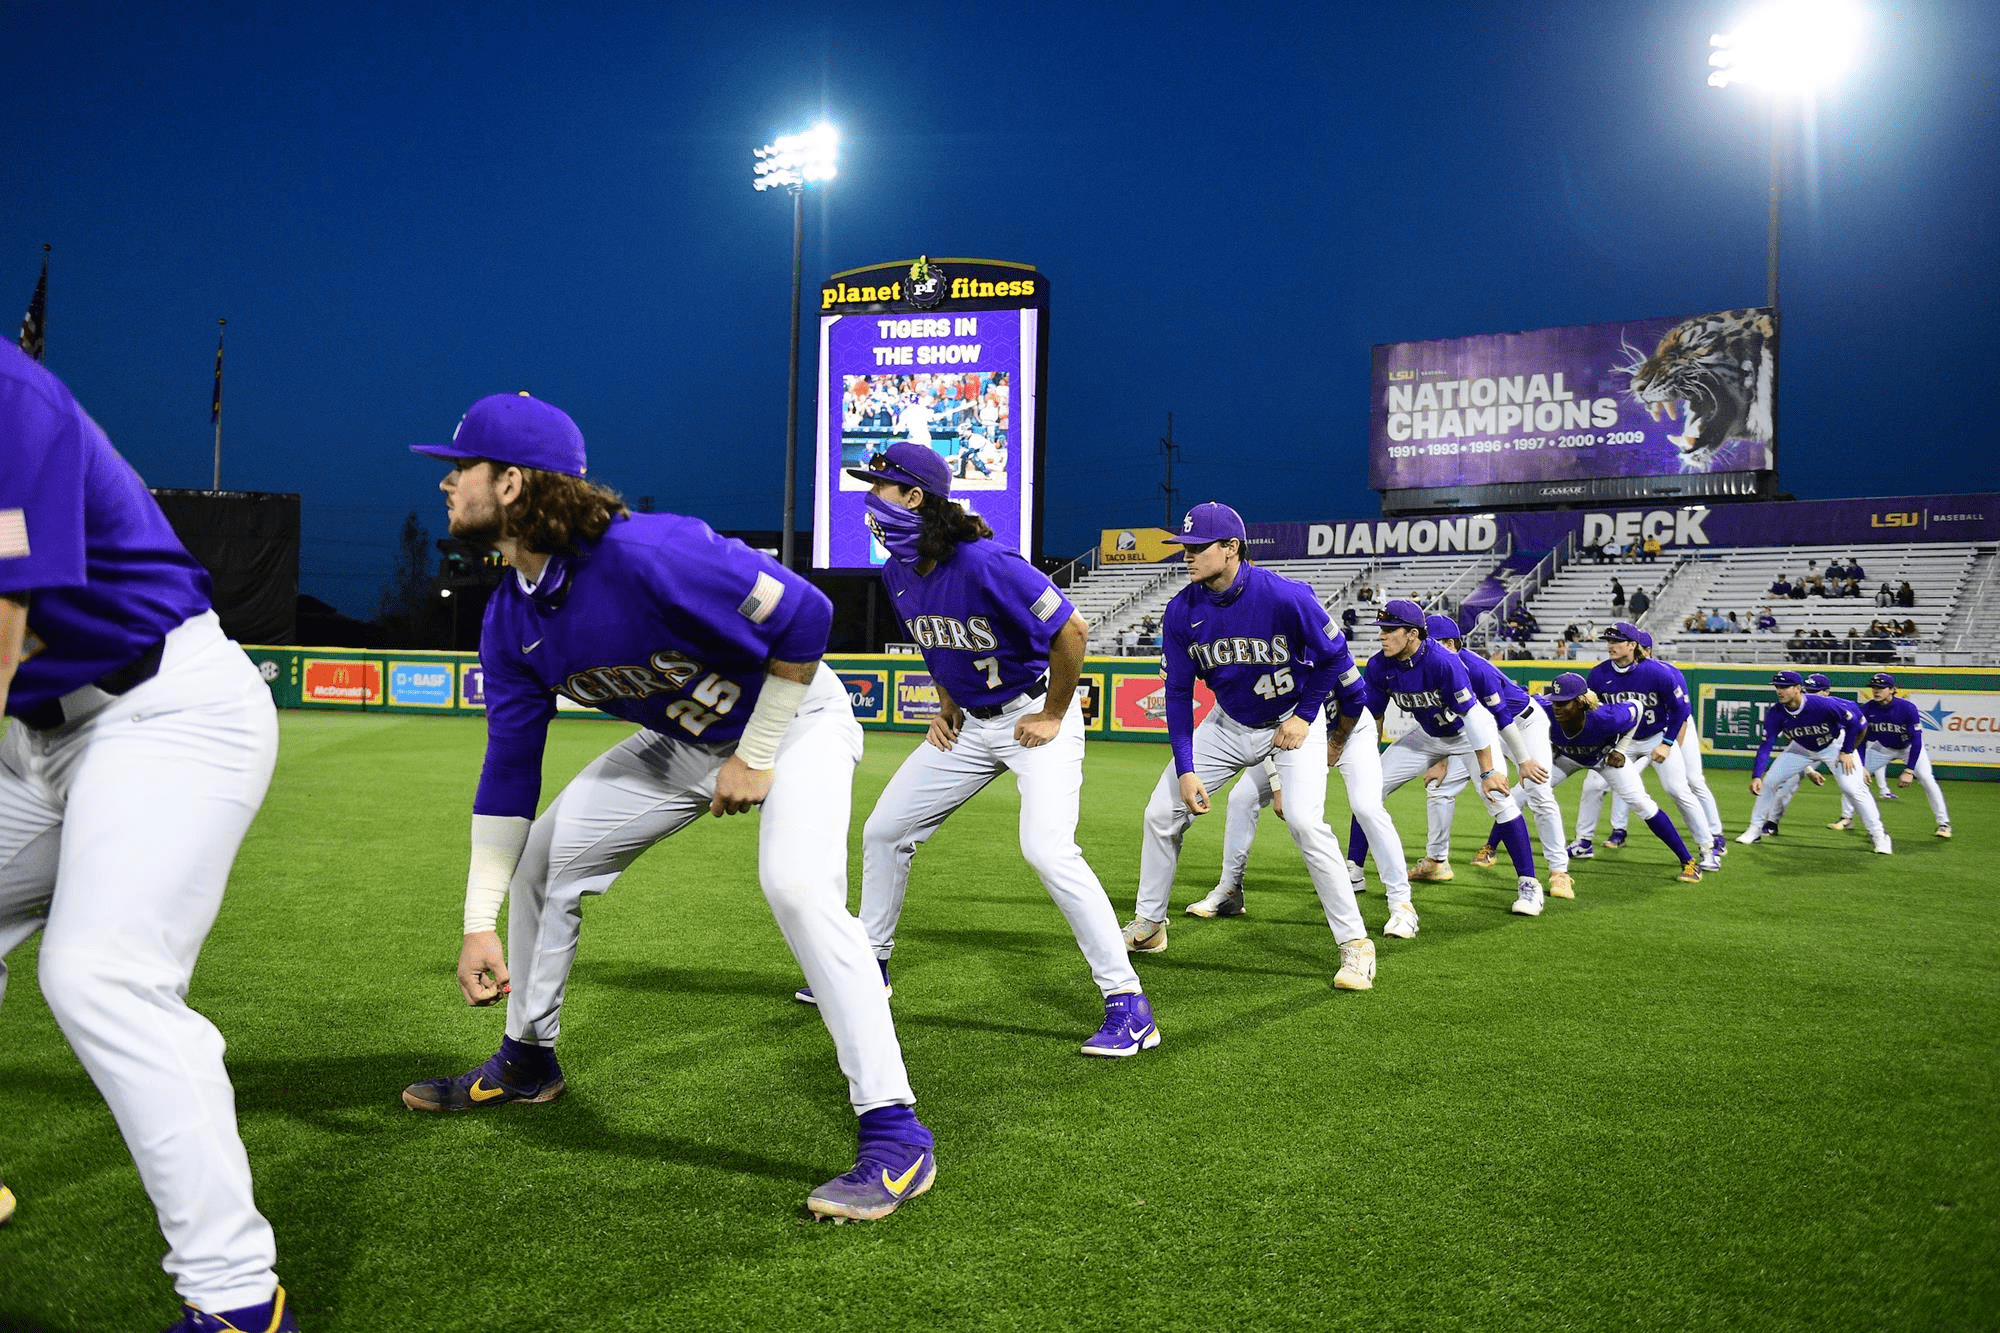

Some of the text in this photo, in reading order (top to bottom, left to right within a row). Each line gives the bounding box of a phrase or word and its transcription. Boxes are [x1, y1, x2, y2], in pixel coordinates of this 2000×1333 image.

[821, 277, 1035, 309] planet fitness
[913, 278, 938, 296] pf
[877, 317, 977, 340] TIGERS IN
[872, 344, 982, 366] THE SHOW
[1388, 370, 1415, 381] LSU
[1388, 372, 1573, 413] NATIONAL
[1387, 397, 1618, 441] CHAMPIONS
[1387, 431, 1645, 458] 1991 1993 1996 1997 2000 2009
[1307, 508, 1711, 556] DIAMOND DECK
[1871, 511, 1984, 528] LSU BASEBALL
[1105, 552, 1147, 562] TACO BELL
[1189, 635, 1291, 670] TIGERS
[973, 656, 1003, 690] 7
[1253, 667, 1295, 700] 45
[665, 672, 742, 737] 25
[1644, 709, 1656, 726] 3
[1939, 744, 1986, 754] HEATING
